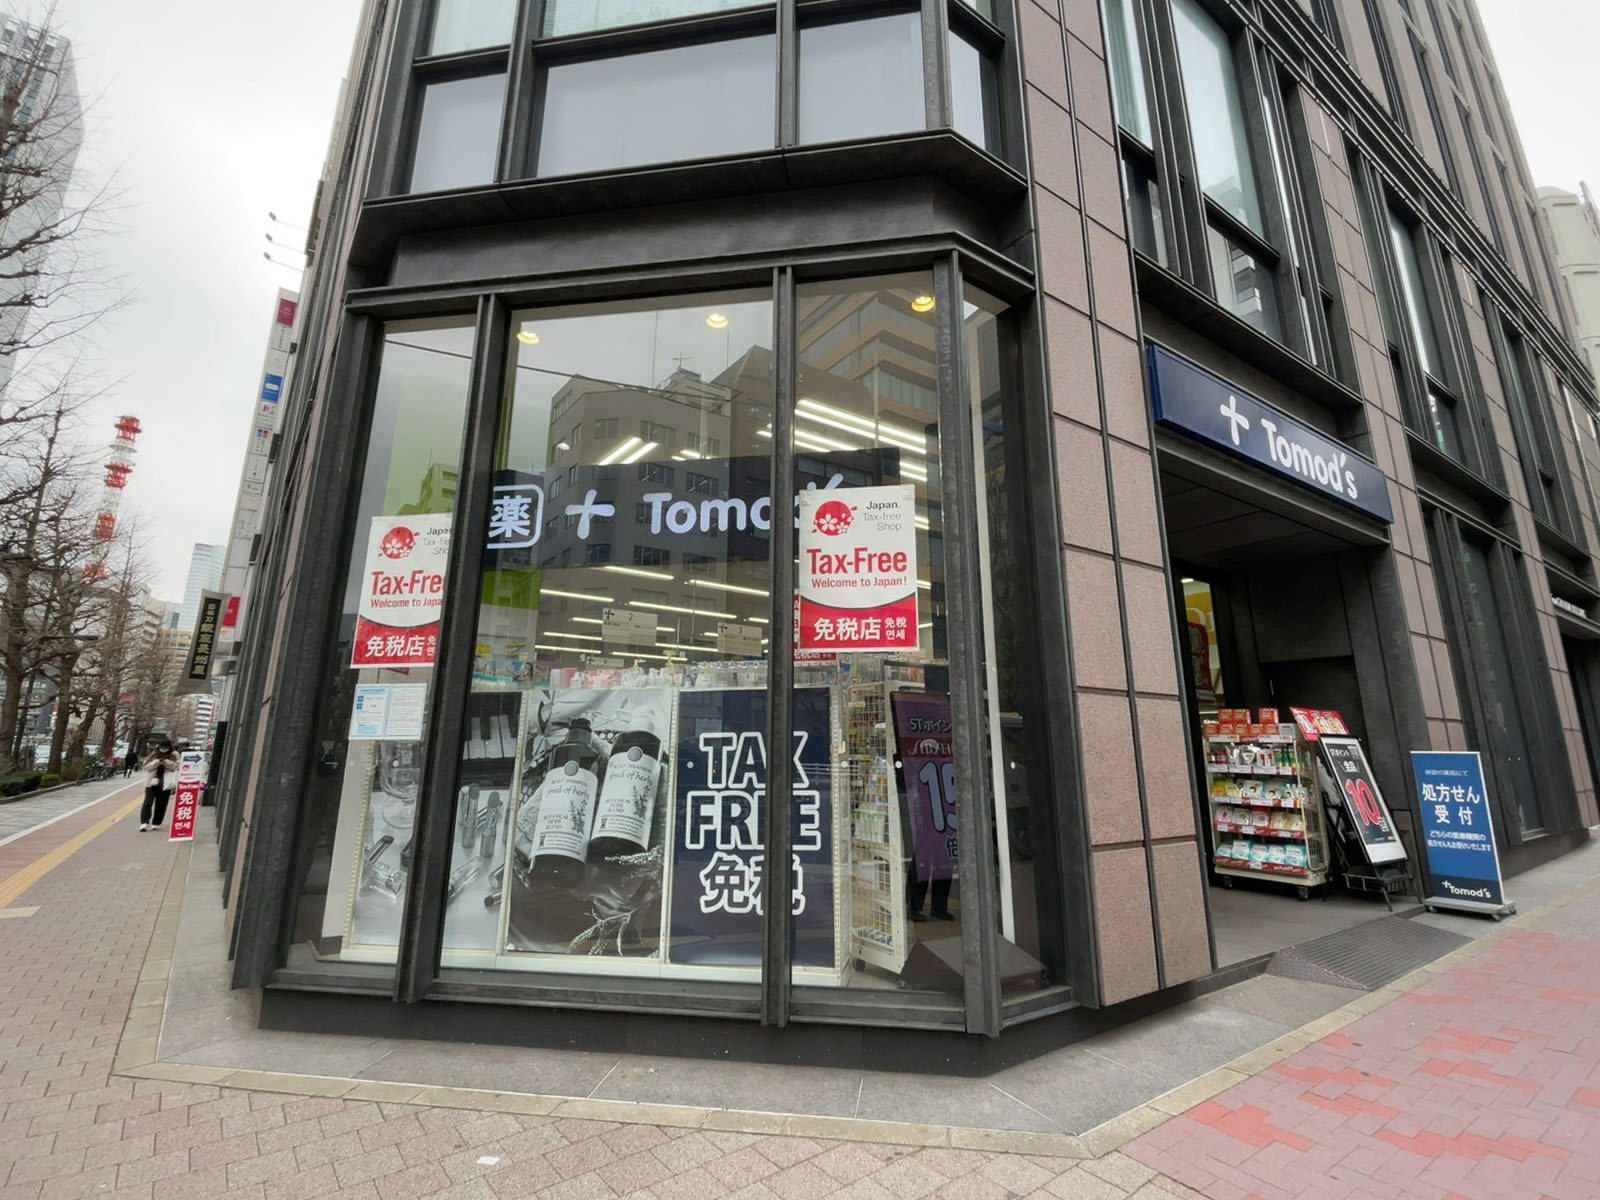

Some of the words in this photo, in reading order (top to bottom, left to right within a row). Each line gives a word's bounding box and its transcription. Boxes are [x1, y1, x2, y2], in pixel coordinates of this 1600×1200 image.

[1260, 418, 1358, 500] Tomod's
[488, 495, 533, 539] 薬
[862, 512, 902, 521] Tax-free
[876, 522, 902, 532] Shop
[433, 546, 448, 556] Sho
[806, 547, 907, 575] Tax-Free
[370, 569, 445, 596] Tax-Fre
[811, 578, 857, 588] Welcome
[860, 577, 871, 587] to
[873, 576, 907, 588] Japan!
[370, 598, 410, 608] Welcome
[412, 599, 422, 607] to
[813, 616, 881, 642] 免税店
[885, 629, 906, 641] 면세
[364, 634, 425, 657] 免税店
[910, 717, 952, 732] STポイン
[1344, 777, 1381, 826] 10
[1422, 782, 1480, 804] 処方せん
[176, 791, 195, 820] 免税
[1449, 884, 1492, 899] Tomod's
